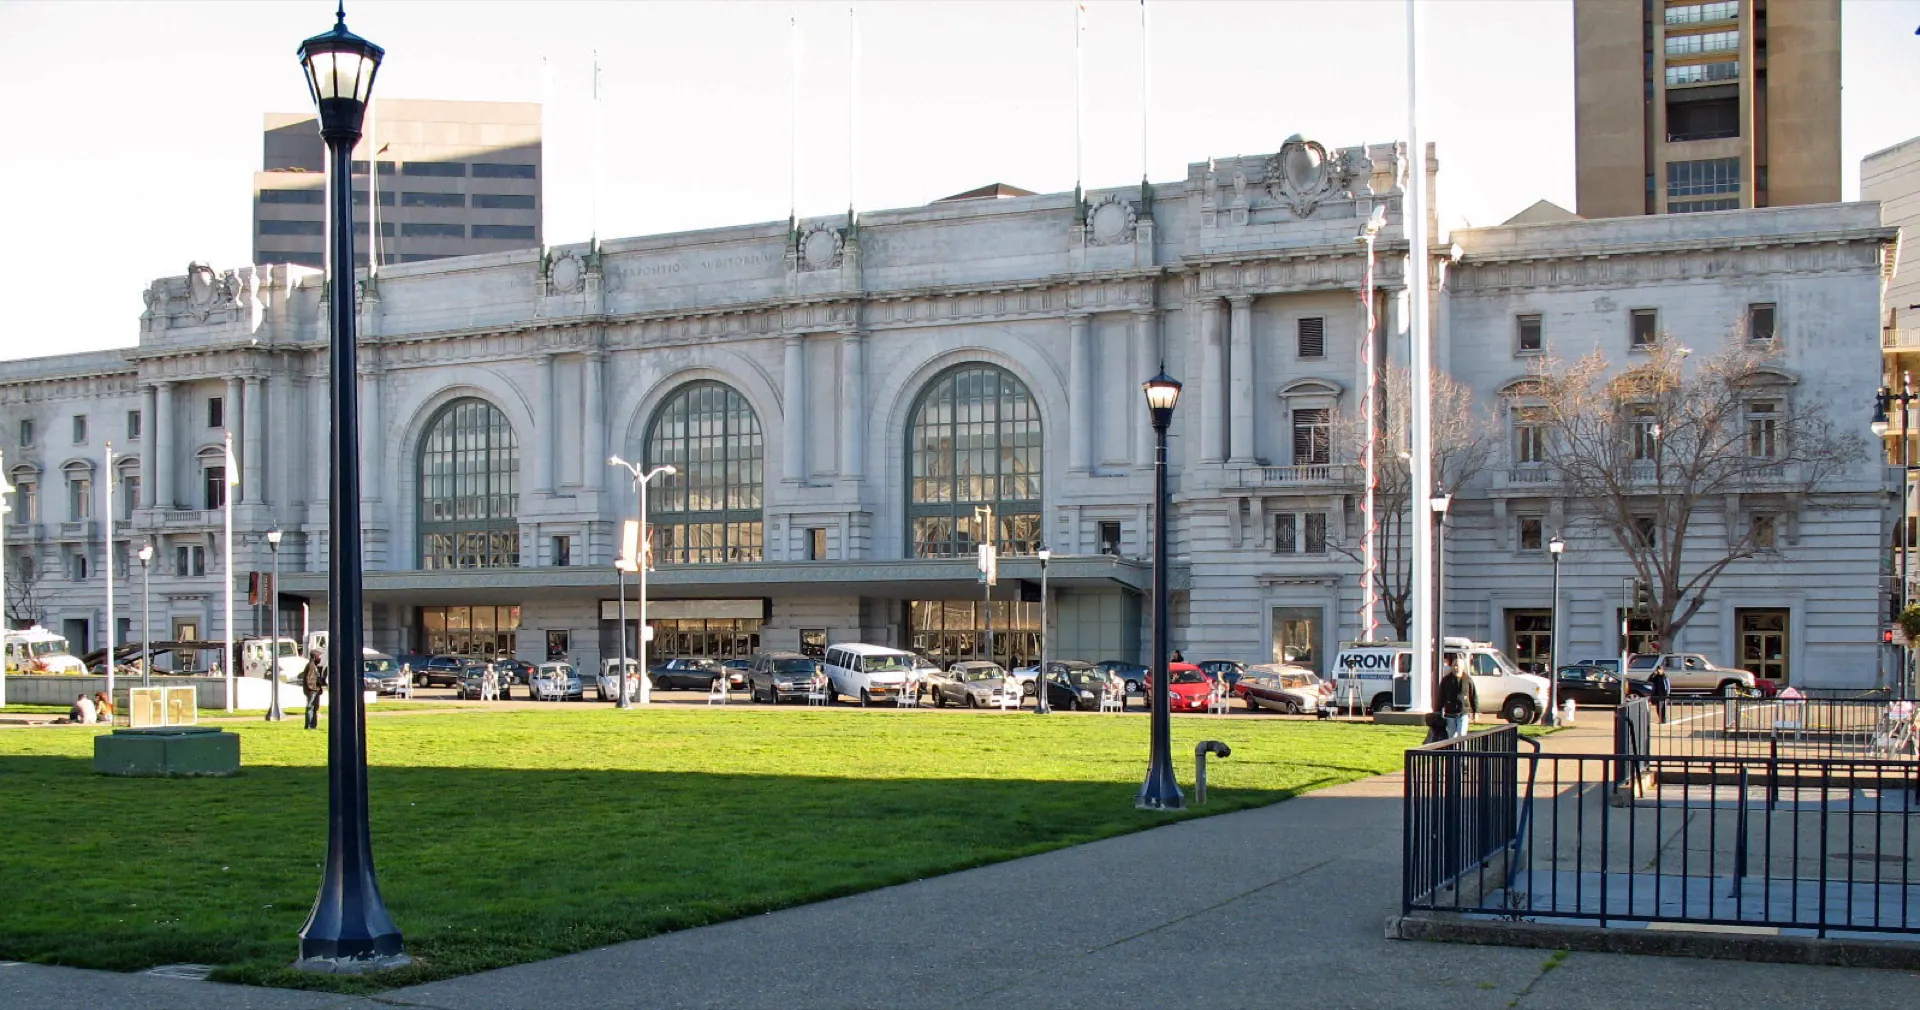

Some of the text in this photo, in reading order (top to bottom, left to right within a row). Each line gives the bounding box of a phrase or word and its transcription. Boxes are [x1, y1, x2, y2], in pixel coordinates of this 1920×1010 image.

[623, 254, 773, 277] EXPOSITION AUDITORIUM
[1340, 654, 1391, 668] KRON
